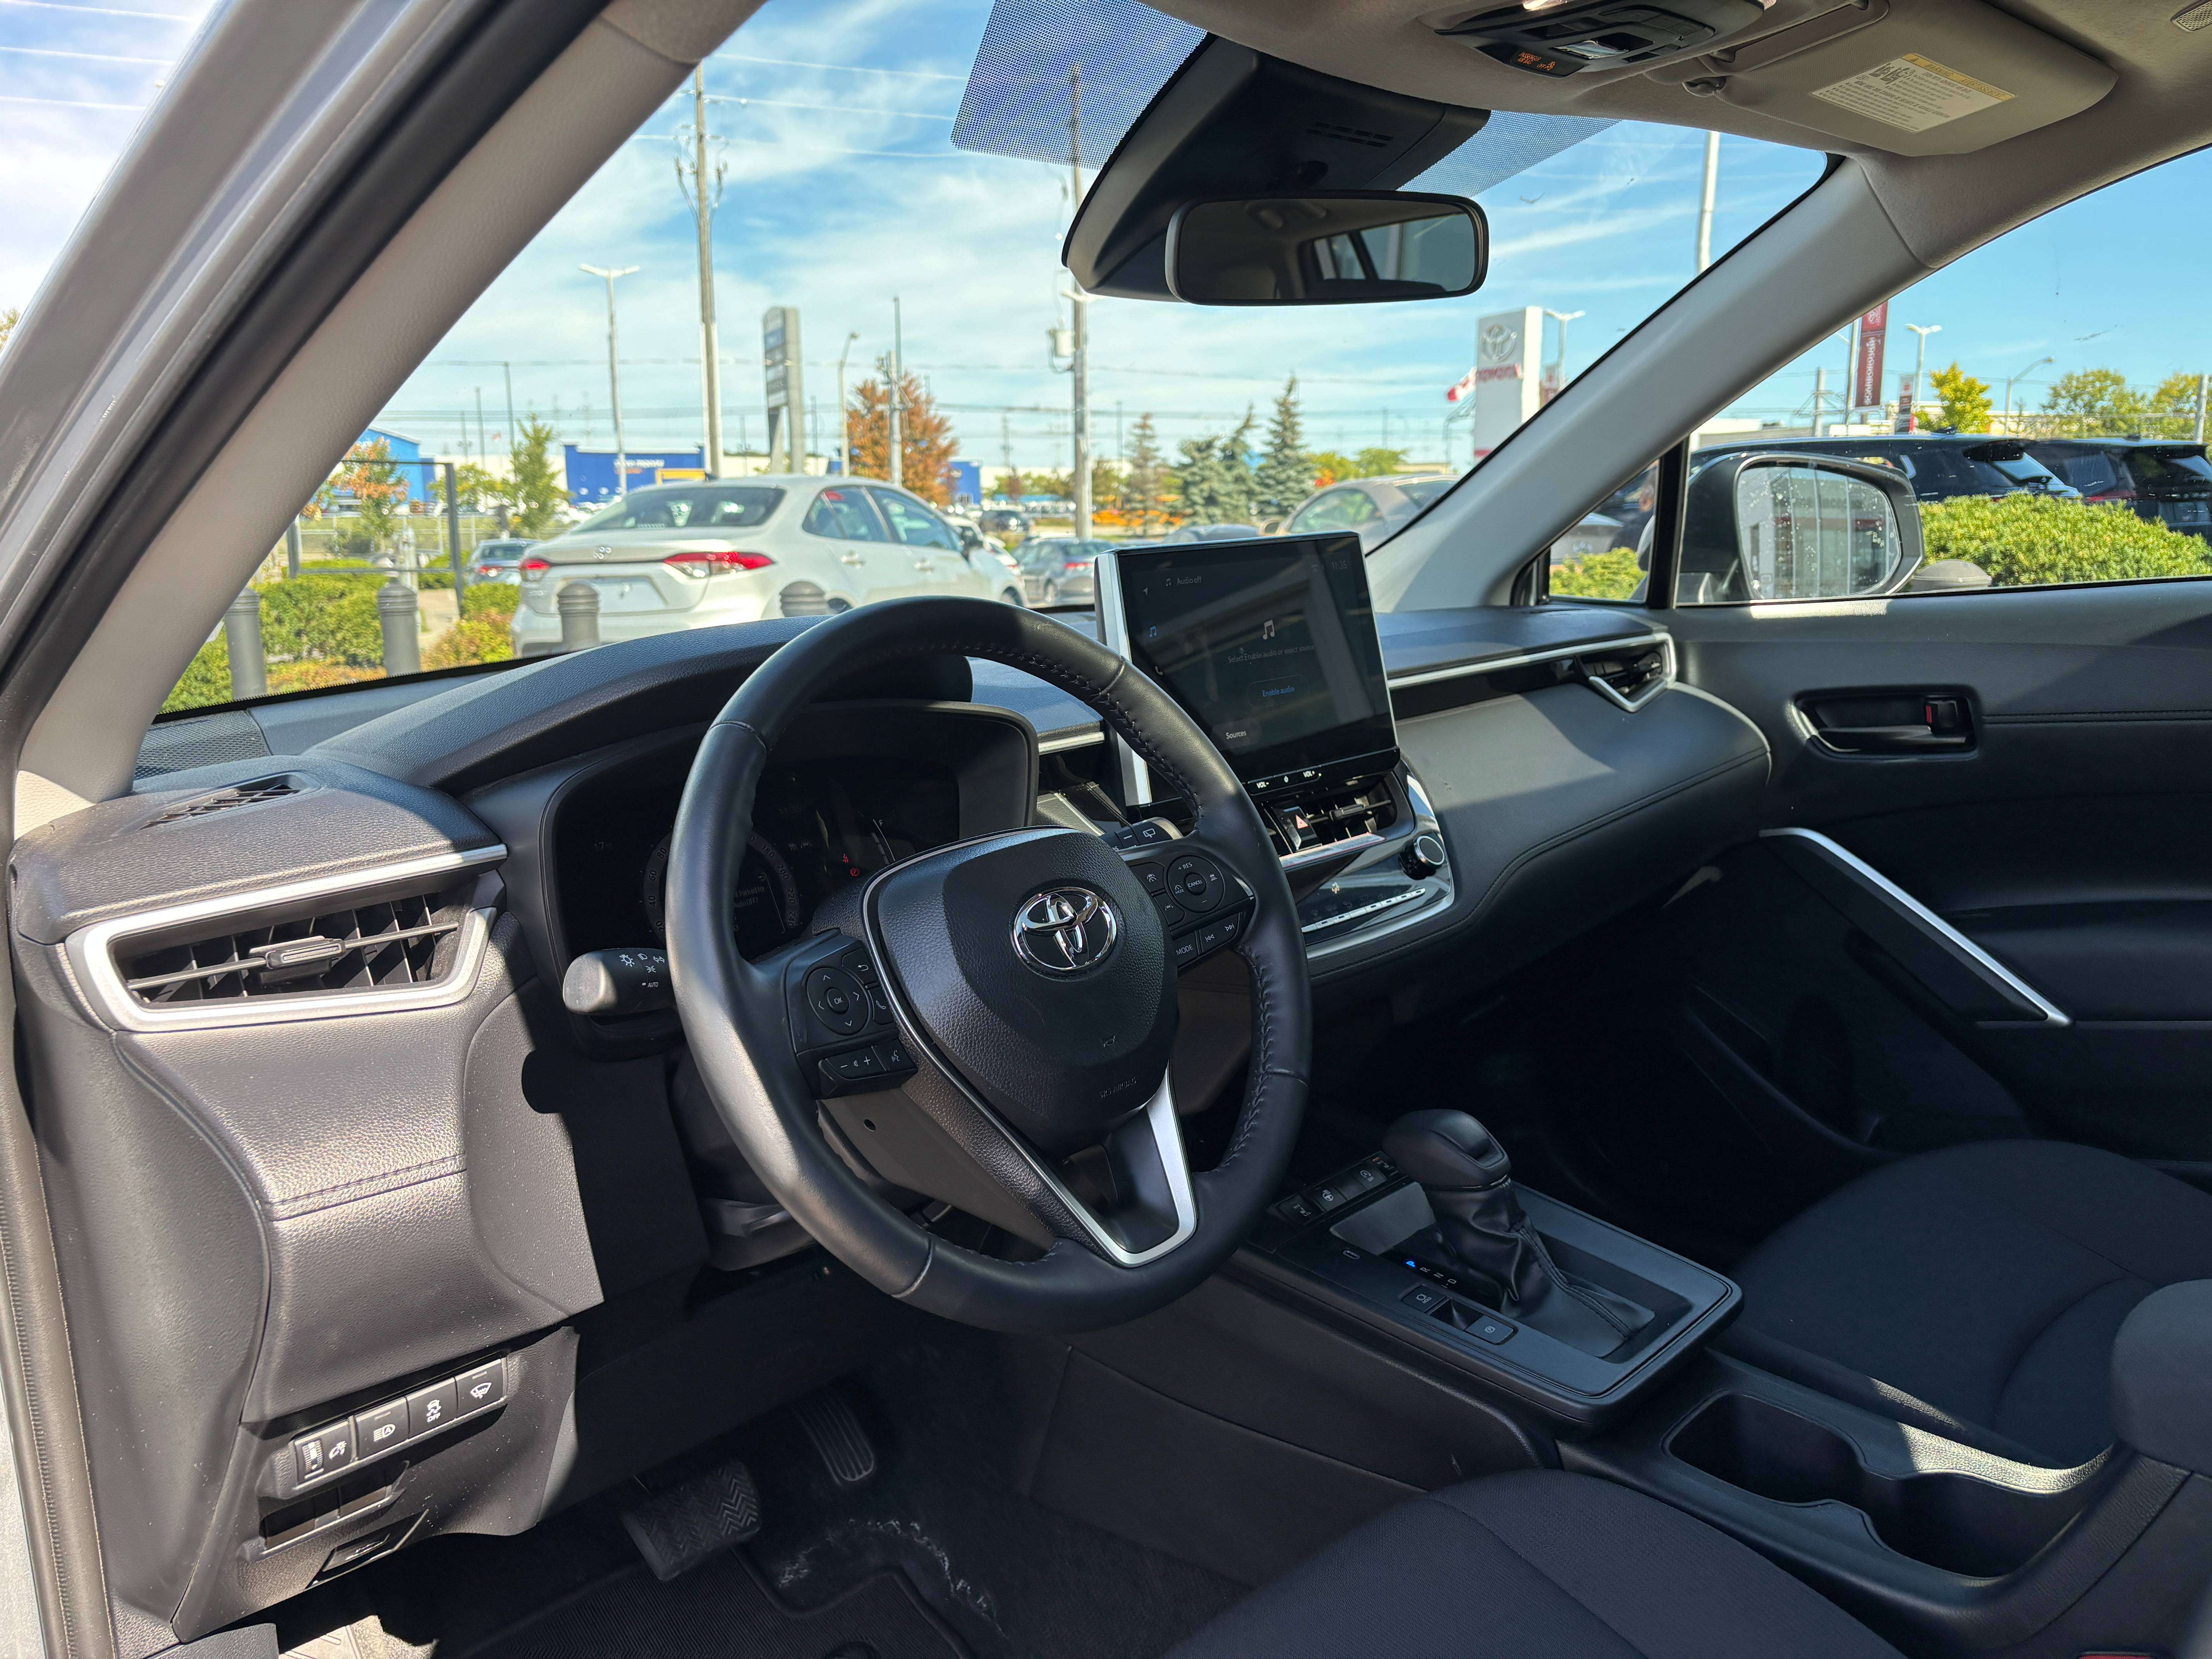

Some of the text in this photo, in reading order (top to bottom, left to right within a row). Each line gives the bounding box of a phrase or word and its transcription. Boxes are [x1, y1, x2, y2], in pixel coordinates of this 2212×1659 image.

[1177, 577, 1193, 585] Audio
[1262, 685, 1295, 697] Enable audio
[1226, 731, 1247, 739] Sources
[657, 847, 667, 859] 80
[762, 845, 775, 858] 180
[649, 870, 657, 881] 60
[778, 865, 789, 880] 200
[648, 895, 656, 907] 40
[787, 888, 795, 904] 220
[788, 911, 796, 927] 240
[1176, 944, 1193, 955] MODE
[427, 1412, 441, 1422] OFF
